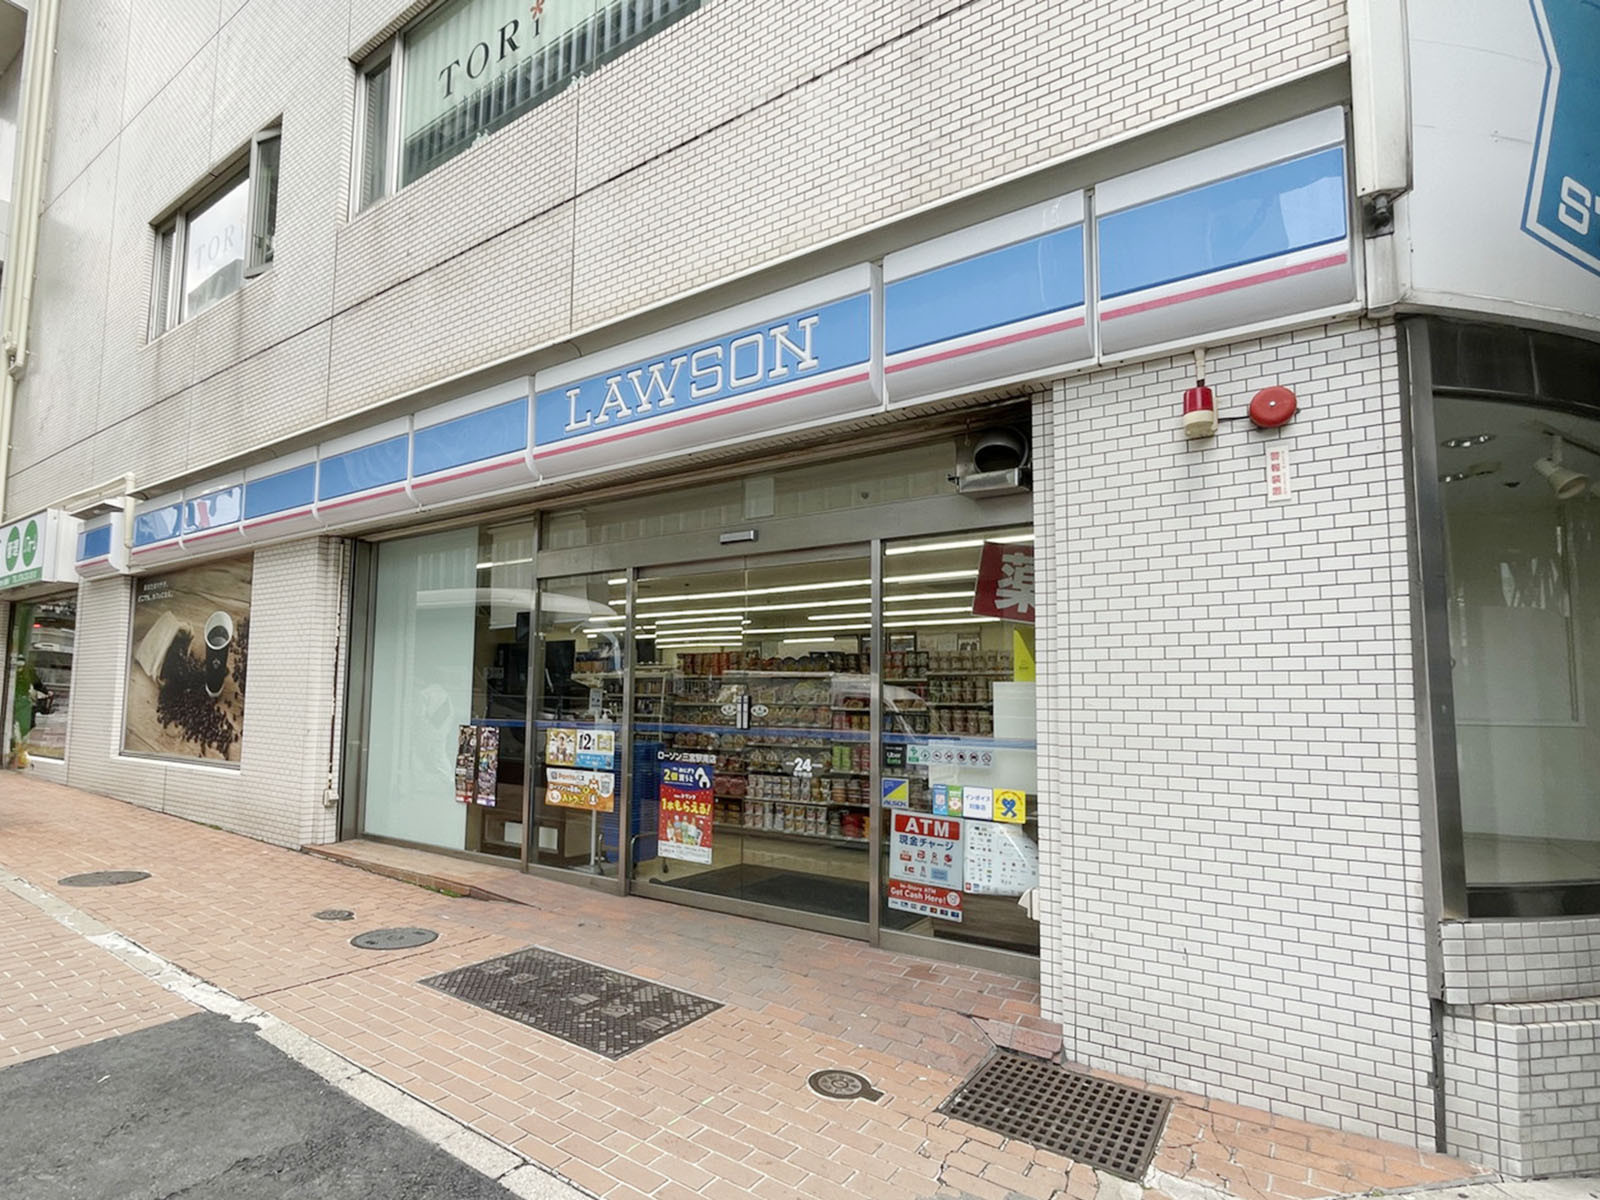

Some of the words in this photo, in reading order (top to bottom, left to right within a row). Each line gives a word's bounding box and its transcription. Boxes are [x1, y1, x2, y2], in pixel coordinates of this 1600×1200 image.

[1558, 175, 1600, 236] S
[564, 313, 820, 432] LAWSON
[578, 733, 592, 750] 12
[794, 757, 812, 772] 24
[904, 817, 950, 838] ATM
[899, 834, 955, 851] 現金チャージ
[890, 888, 903, 896] Get
[904, 890, 923, 901] Cash
[924, 893, 947, 906] Here!
